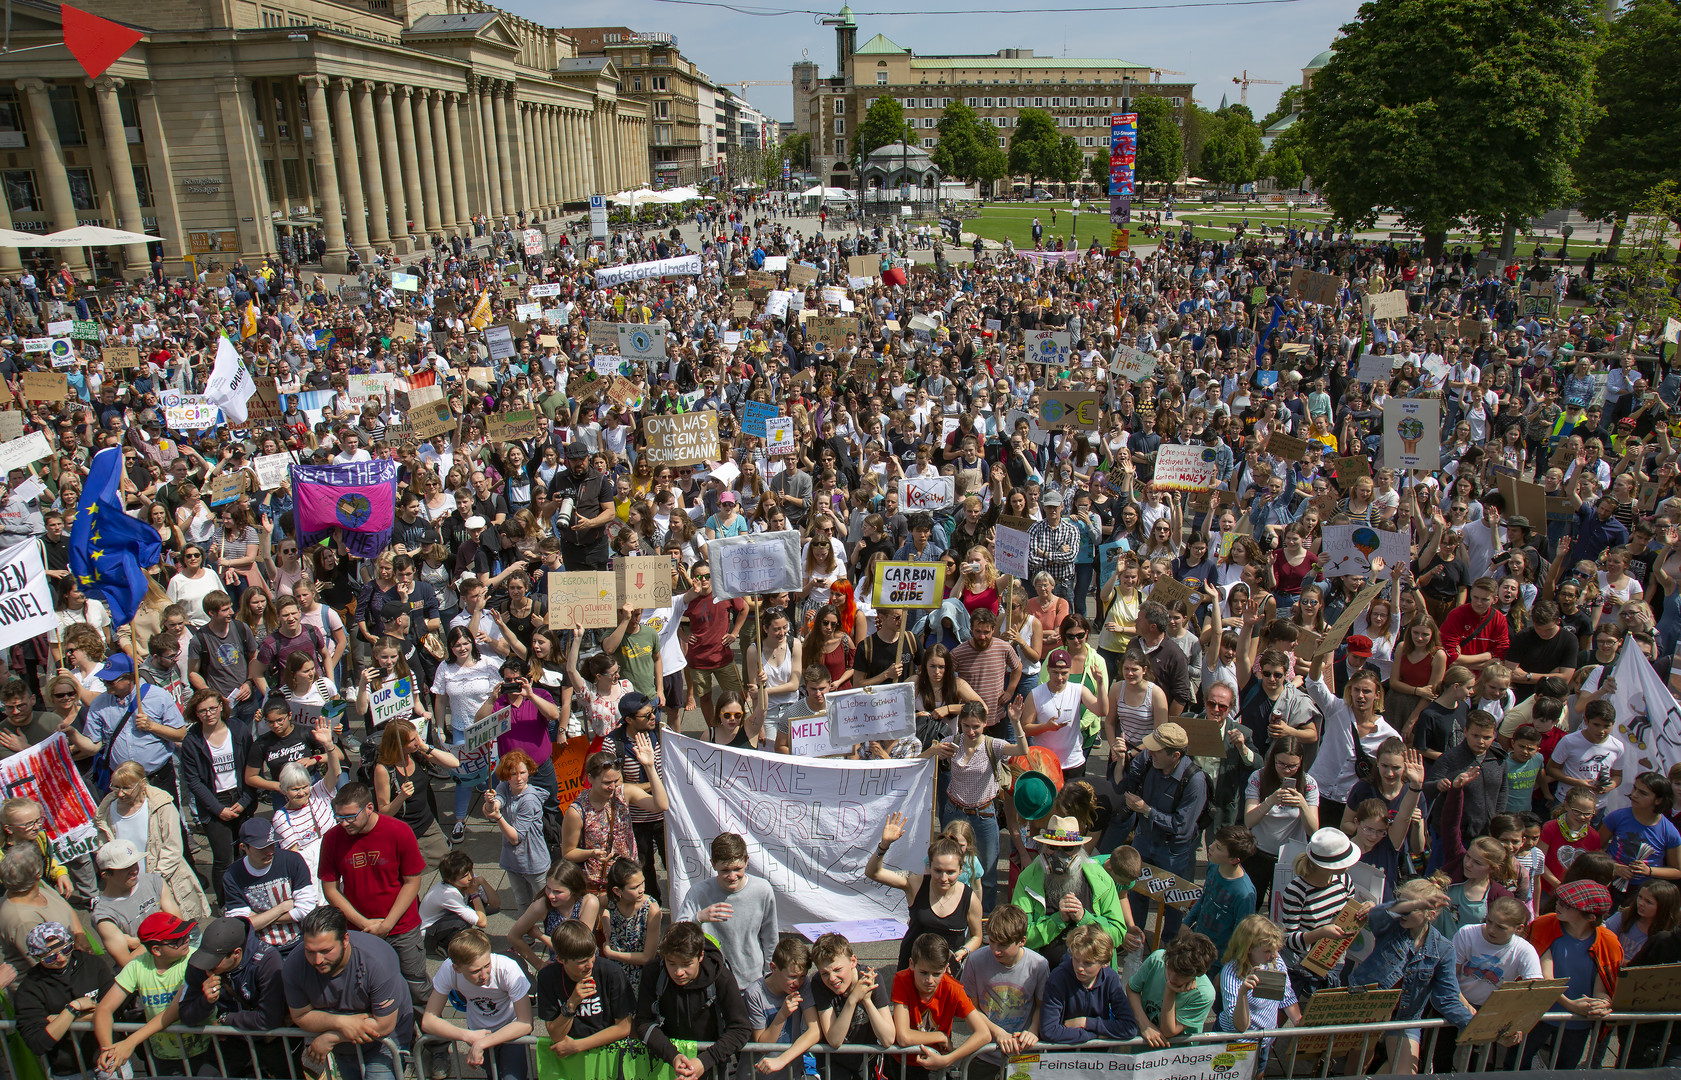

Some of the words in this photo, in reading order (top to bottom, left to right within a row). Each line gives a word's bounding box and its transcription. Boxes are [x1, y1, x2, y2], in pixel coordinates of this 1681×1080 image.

[188, 186, 220, 194] Passagen
[598, 262, 698, 286] #voteforclimate
[818, 327, 852, 336] FUTURE
[1034, 332, 1053, 340] THERE
[1028, 344, 1034, 352] IS
[1032, 352, 1056, 364] PLANET
[1058, 354, 1064, 363] B
[185, 406, 210, 420] ein
[648, 416, 681, 434] OMA,
[682, 414, 708, 430] WAS
[662, 433, 676, 446] IST
[677, 432, 697, 442] EIN
[647, 442, 716, 462] SCHNEEMANN
[770, 445, 794, 455] SCHEISSE
[1160, 446, 1176, 458] Once
[1188, 448, 1200, 457] have
[342, 462, 376, 485] THE
[1179, 474, 1206, 485] MONEY
[722, 545, 759, 558] CHANGE
[762, 543, 780, 552] THE
[638, 560, 669, 570] chillen
[732, 556, 775, 569] POLITICS
[554, 574, 598, 586] DEGROWTH
[732, 570, 754, 581] NOT
[758, 568, 776, 578] THE
[885, 567, 936, 581] CARBON
[739, 580, 773, 592] CLIMATE
[890, 590, 924, 602] OXIDE
[563, 604, 584, 627] 30
[584, 603, 612, 612] STUNDEN
[585, 617, 610, 625] WOCHE
[373, 688, 392, 704] OUR
[374, 694, 410, 720] FUTURE
[840, 698, 868, 708] Lieber
[467, 717, 490, 734] THERE
[491, 714, 498, 722] IS
[498, 709, 510, 721] NO
[468, 724, 498, 750] PLANET
[500, 721, 508, 733] B
[792, 722, 824, 739] MELT
[794, 744, 809, 756] not
[814, 742, 826, 752] ice
[686, 748, 812, 796] MAKE
[838, 767, 908, 797] THE
[718, 798, 866, 842] WORLD
[352, 851, 381, 868] B7
[1149, 877, 1176, 893] fürs
[1164, 889, 1203, 902] Klima
[138, 898, 156, 911] NIKE
[1339, 910, 1350, 923] DU
[1355, 1002, 1377, 1010] EUCH
[1326, 1010, 1356, 1019] MOND
[1039, 1060, 1104, 1071] Feinstaub
[1108, 1056, 1168, 1072] Baustaub
[1172, 1054, 1213, 1067] Abgas
[1200, 1070, 1240, 1080] Lunge
